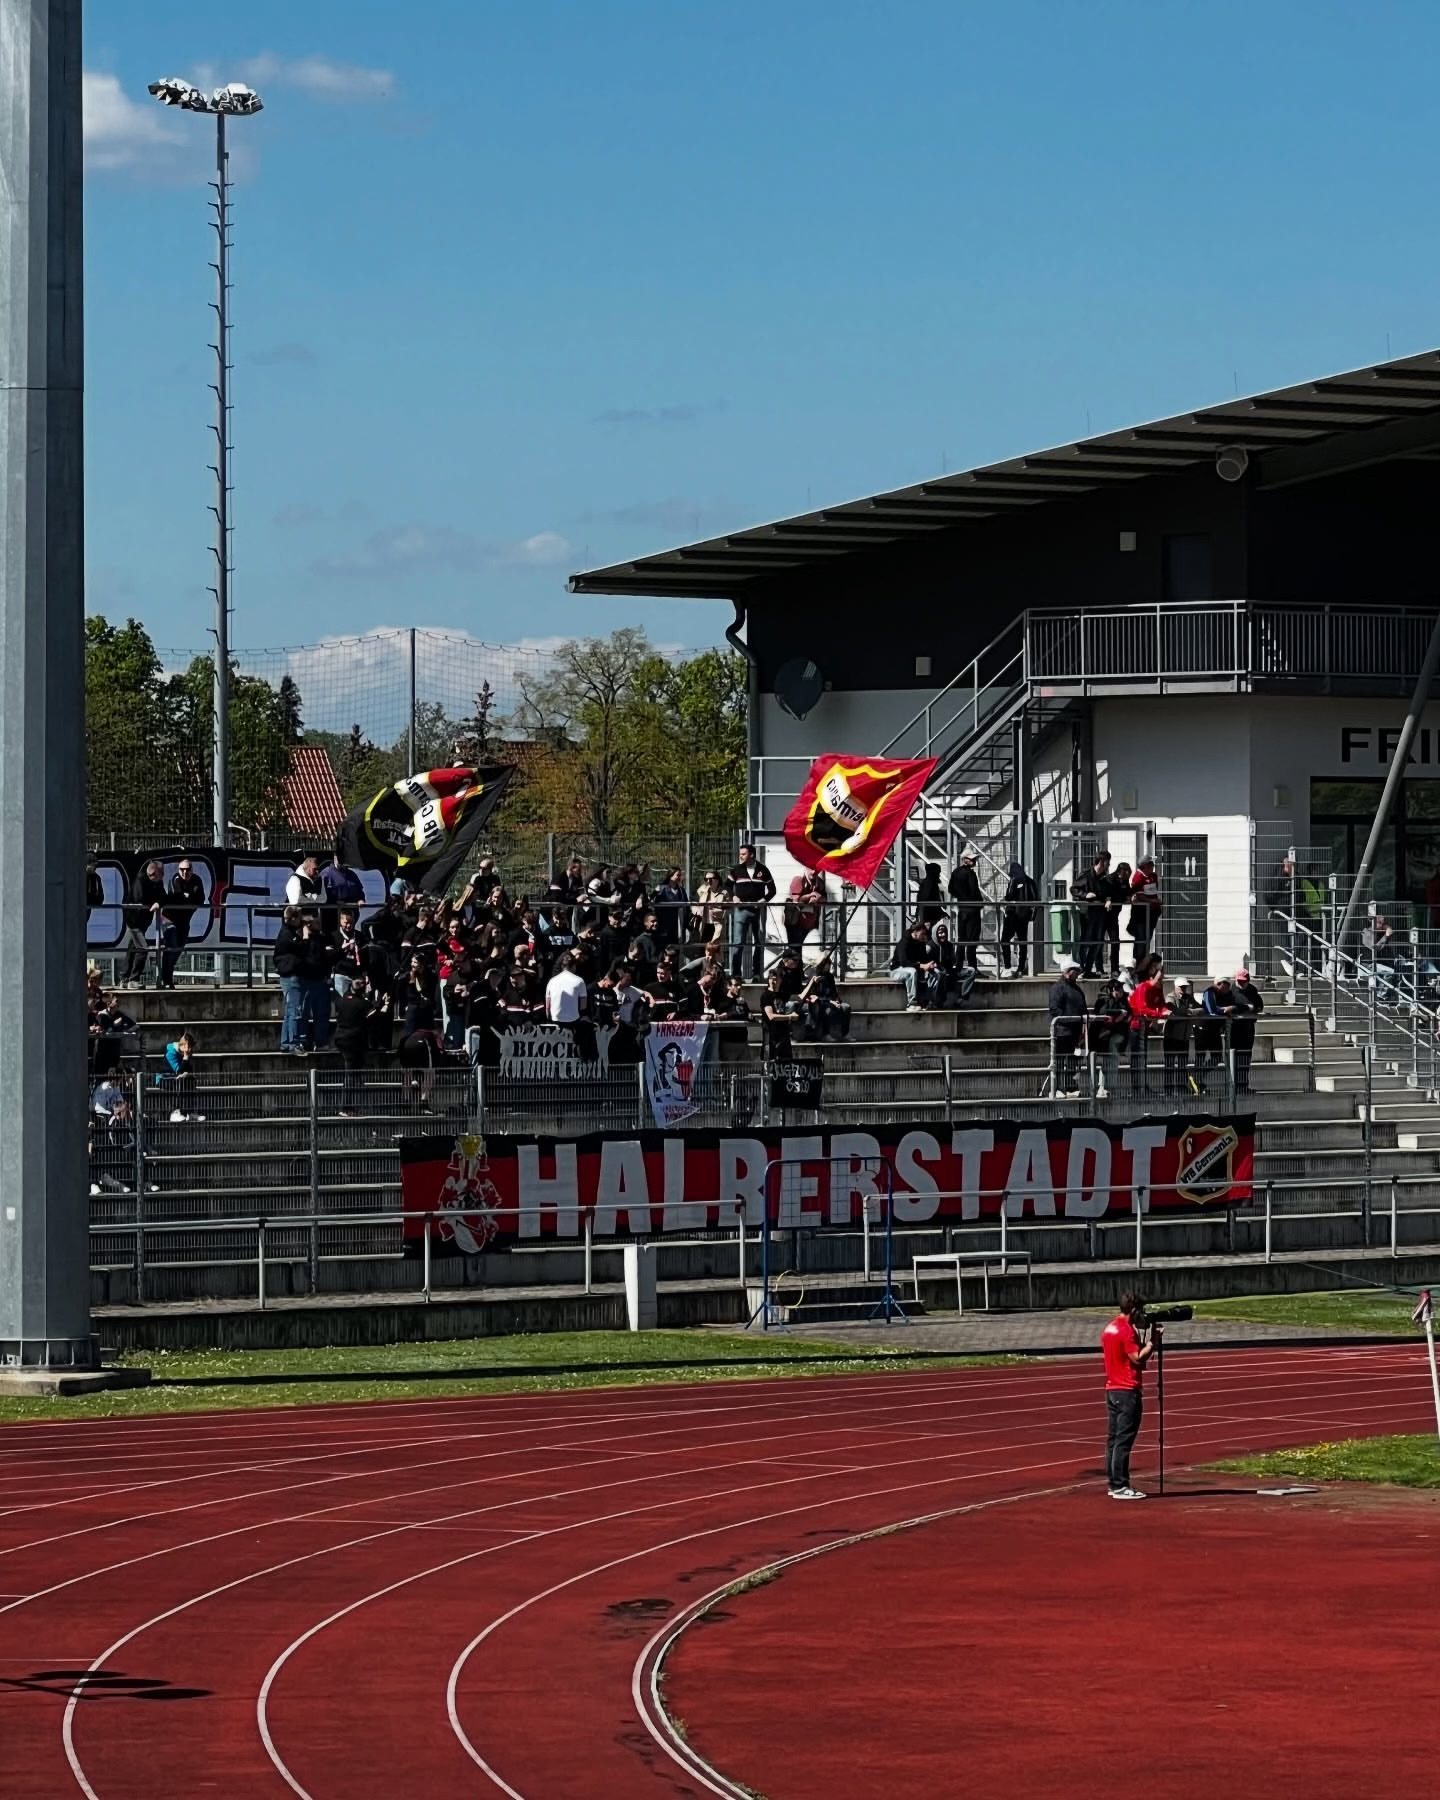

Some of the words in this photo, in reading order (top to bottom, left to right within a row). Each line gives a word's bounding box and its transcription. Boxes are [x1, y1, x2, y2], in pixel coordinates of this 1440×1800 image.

[1342, 728, 1440, 763] FRI
[513, 1041, 581, 1058] BLOCK
[1195, 1136, 1233, 1172] Germania
[517, 1125, 1167, 1237] HALBERSTADT
